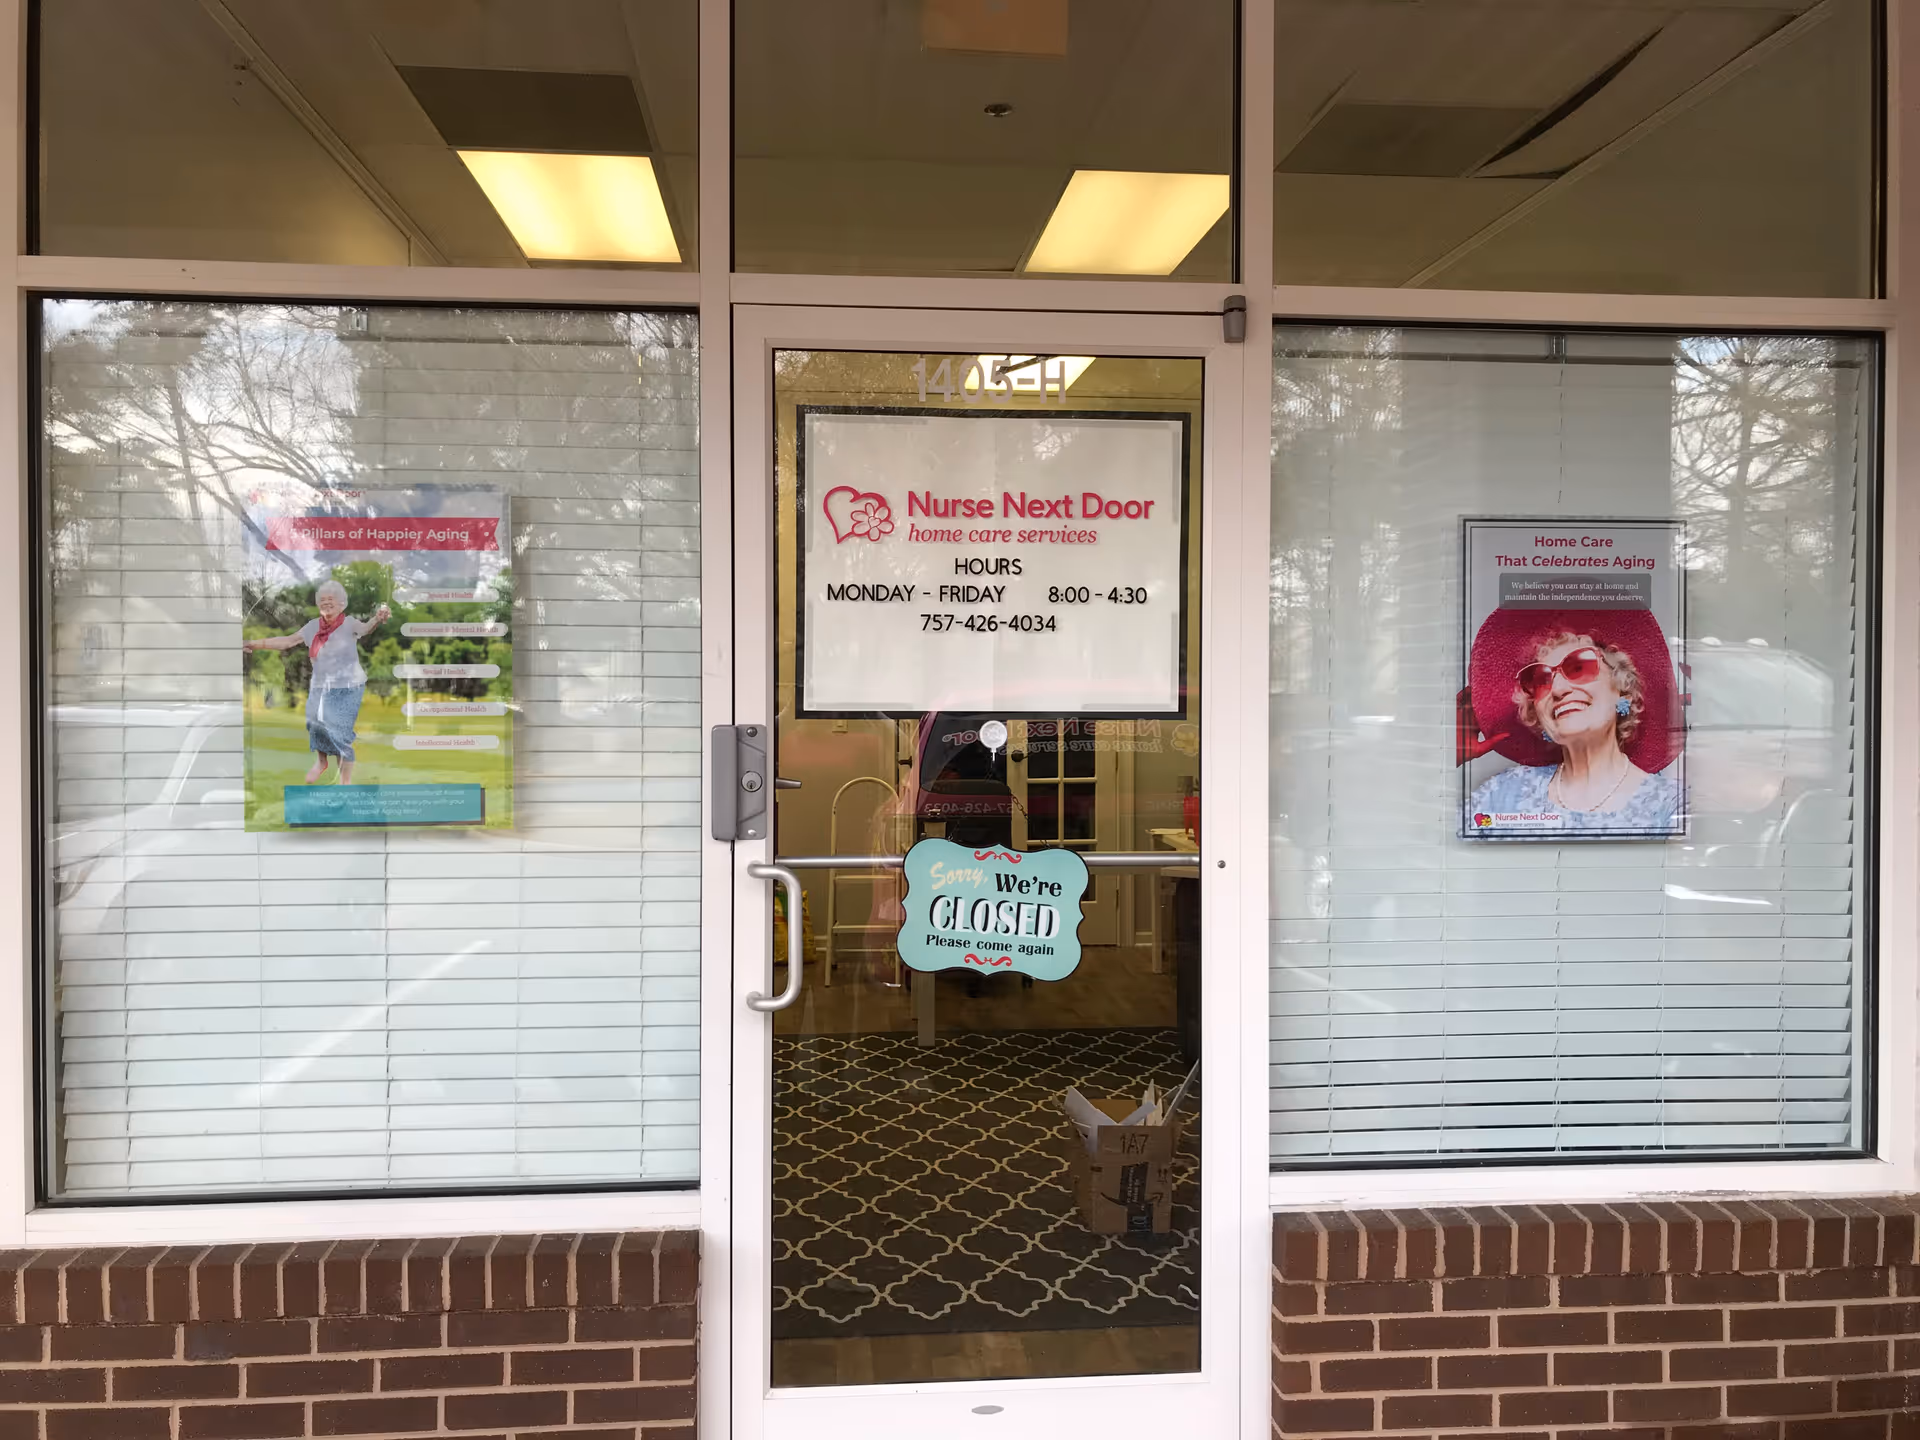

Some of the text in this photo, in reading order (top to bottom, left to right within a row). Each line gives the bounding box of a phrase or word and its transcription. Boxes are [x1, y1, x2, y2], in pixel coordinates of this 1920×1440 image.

[911, 358, 1067, 404] 1405-H
[907, 490, 1155, 520] Nurse Next Door
[302, 528, 345, 540] Pillars
[348, 528, 364, 540] of
[366, 528, 423, 542] Happier
[426, 529, 470, 543] Aging
[908, 523, 1098, 544] home care services
[1534, 536, 1614, 548] Home Care
[954, 557, 1023, 576] HOURS
[1495, 555, 1656, 570] That Celebrates Aging
[826, 584, 916, 602] MONDAY
[938, 585, 1006, 603] FRIDAY
[1047, 586, 1090, 603] 8:00
[1107, 587, 1148, 604] 4:30
[1511, 582, 1524, 590] We
[1525, 581, 1550, 590] believe
[1550, 583, 1565, 591] you
[1579, 582, 1594, 591] stay
[1595, 582, 1603, 590] at
[1625, 582, 1639, 590] and
[1504, 593, 1537, 601] maintain
[1538, 593, 1550, 601] the
[1551, 593, 1600, 602] independence
[920, 614, 1057, 633] 757-426-4034
[1495, 812, 1560, 821] Nurse Next Door
[930, 861, 1063, 897] Sorry, We're
[929, 894, 1061, 940] CLOSED
[925, 934, 1055, 956] Please come again
[1120, 1133, 1149, 1155] 1A7
